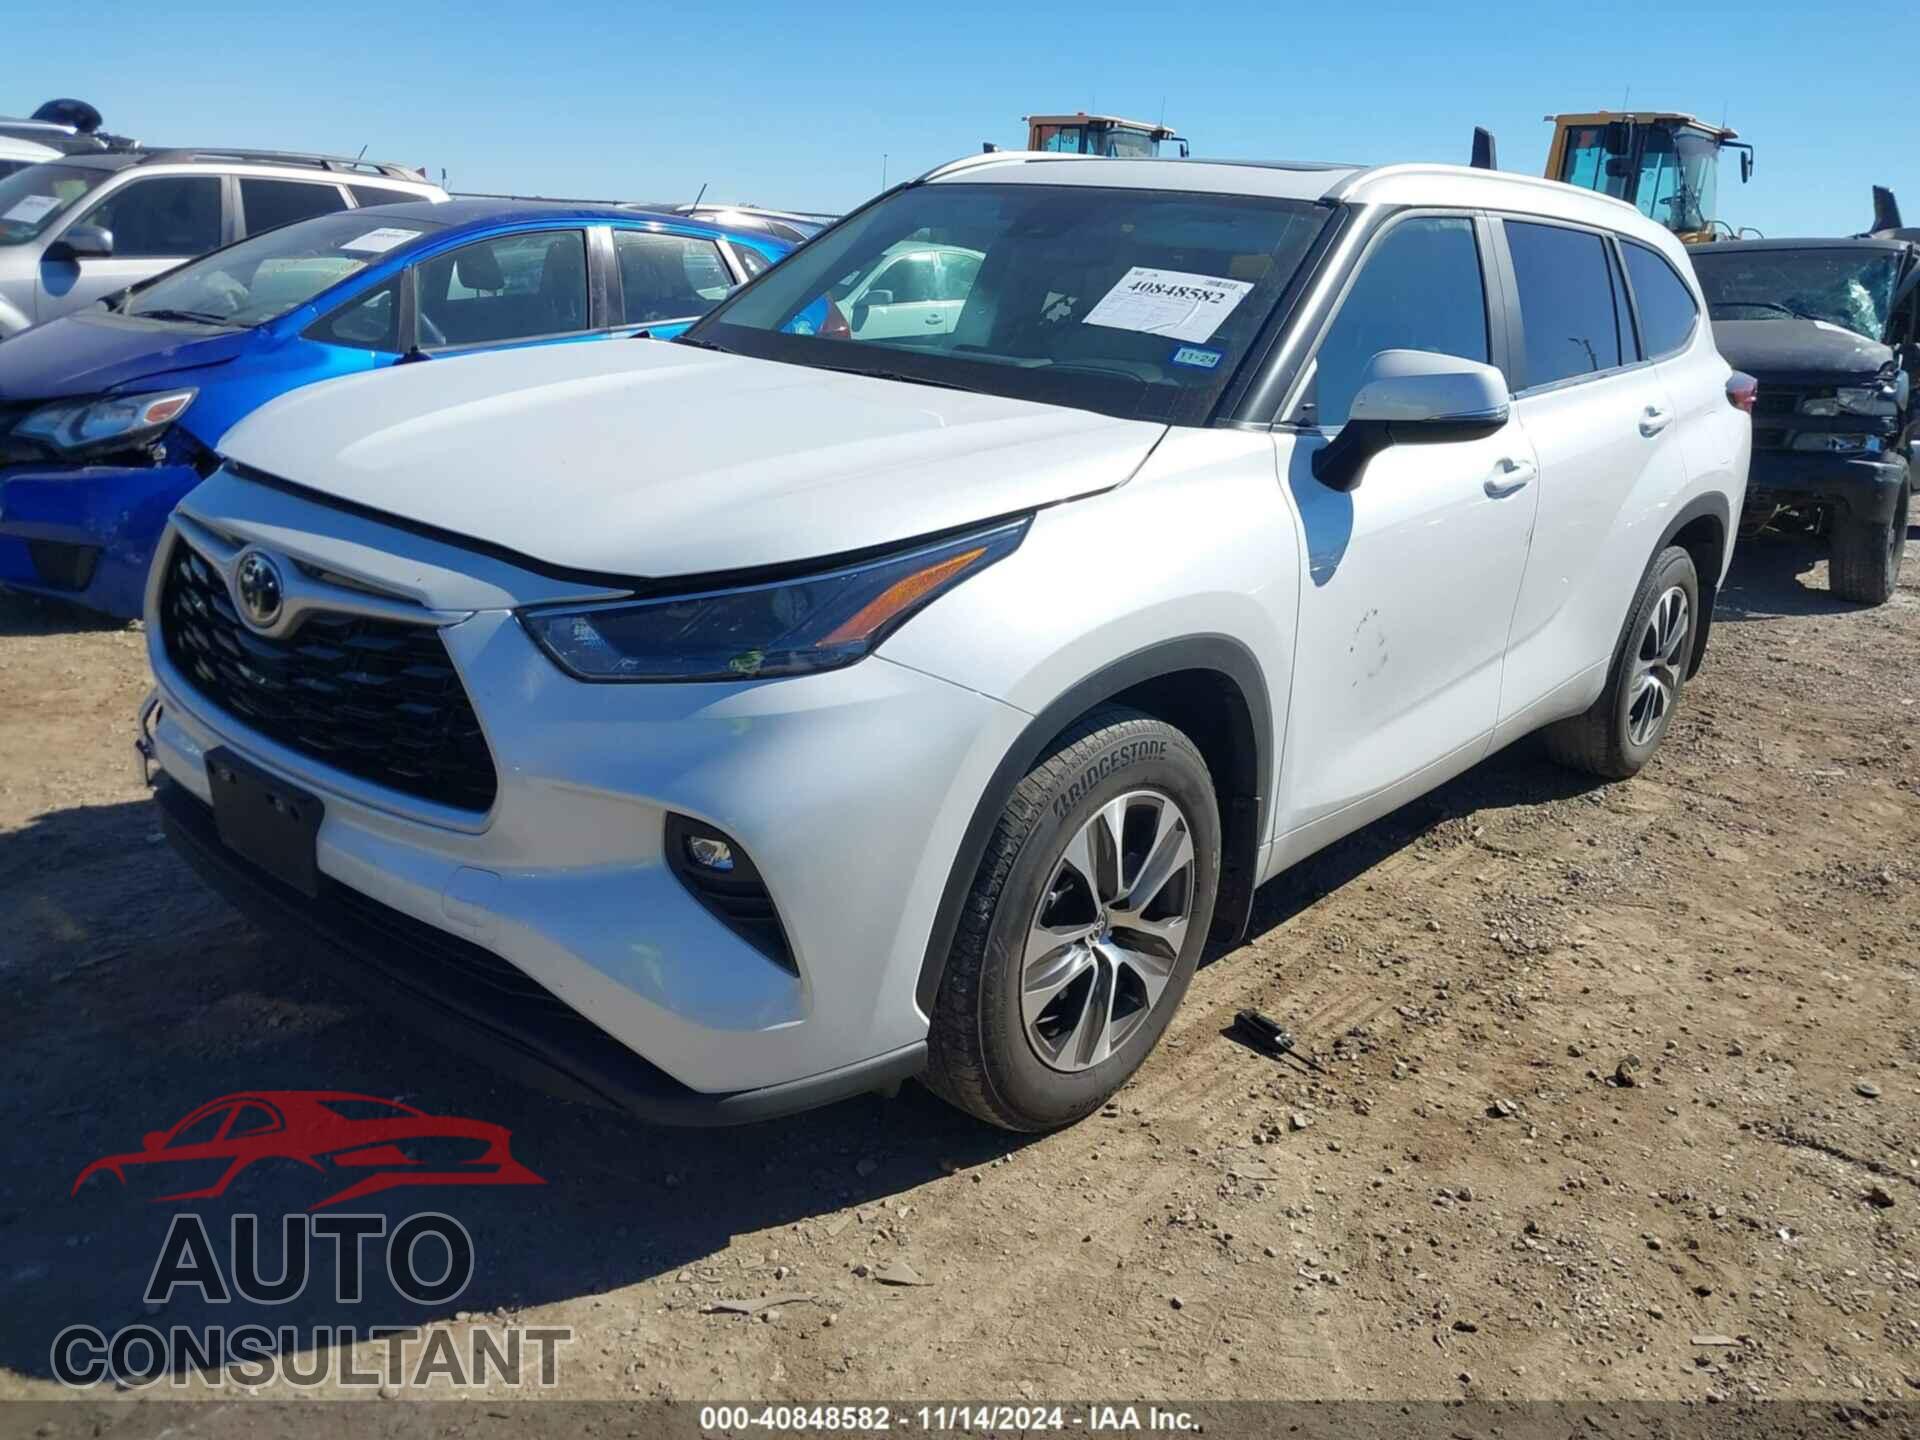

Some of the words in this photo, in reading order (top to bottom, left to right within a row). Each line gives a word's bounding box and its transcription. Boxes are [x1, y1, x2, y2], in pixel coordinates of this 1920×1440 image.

[1128, 280, 1226, 304] 40848582
[1179, 350, 1217, 365] 11-24
[1053, 740, 1167, 817] BRIDGESTONE
